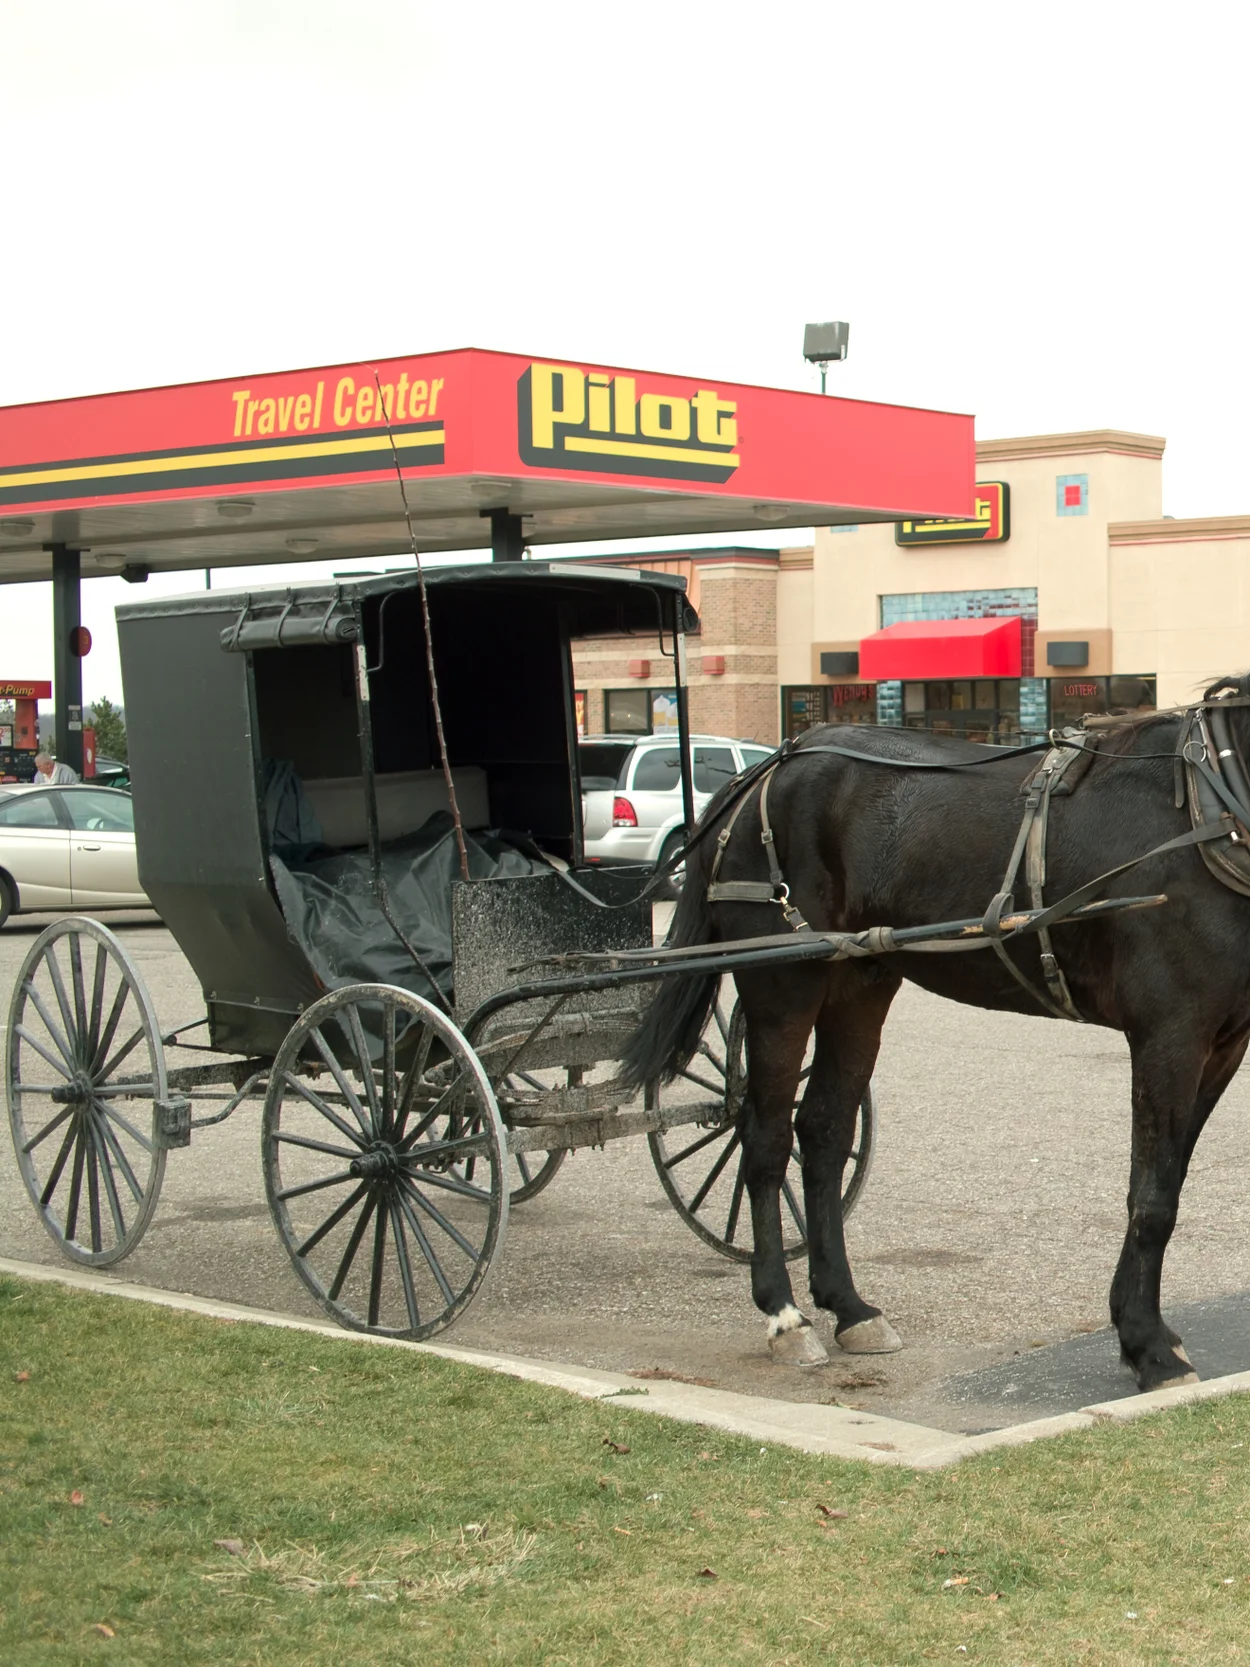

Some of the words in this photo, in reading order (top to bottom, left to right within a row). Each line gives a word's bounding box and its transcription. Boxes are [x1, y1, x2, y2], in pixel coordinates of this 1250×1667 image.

[231, 381, 325, 437] Travel
[333, 372, 445, 427] Center
[530, 362, 738, 449] Pilot
[1063, 684, 1098, 696] LOTTERY
